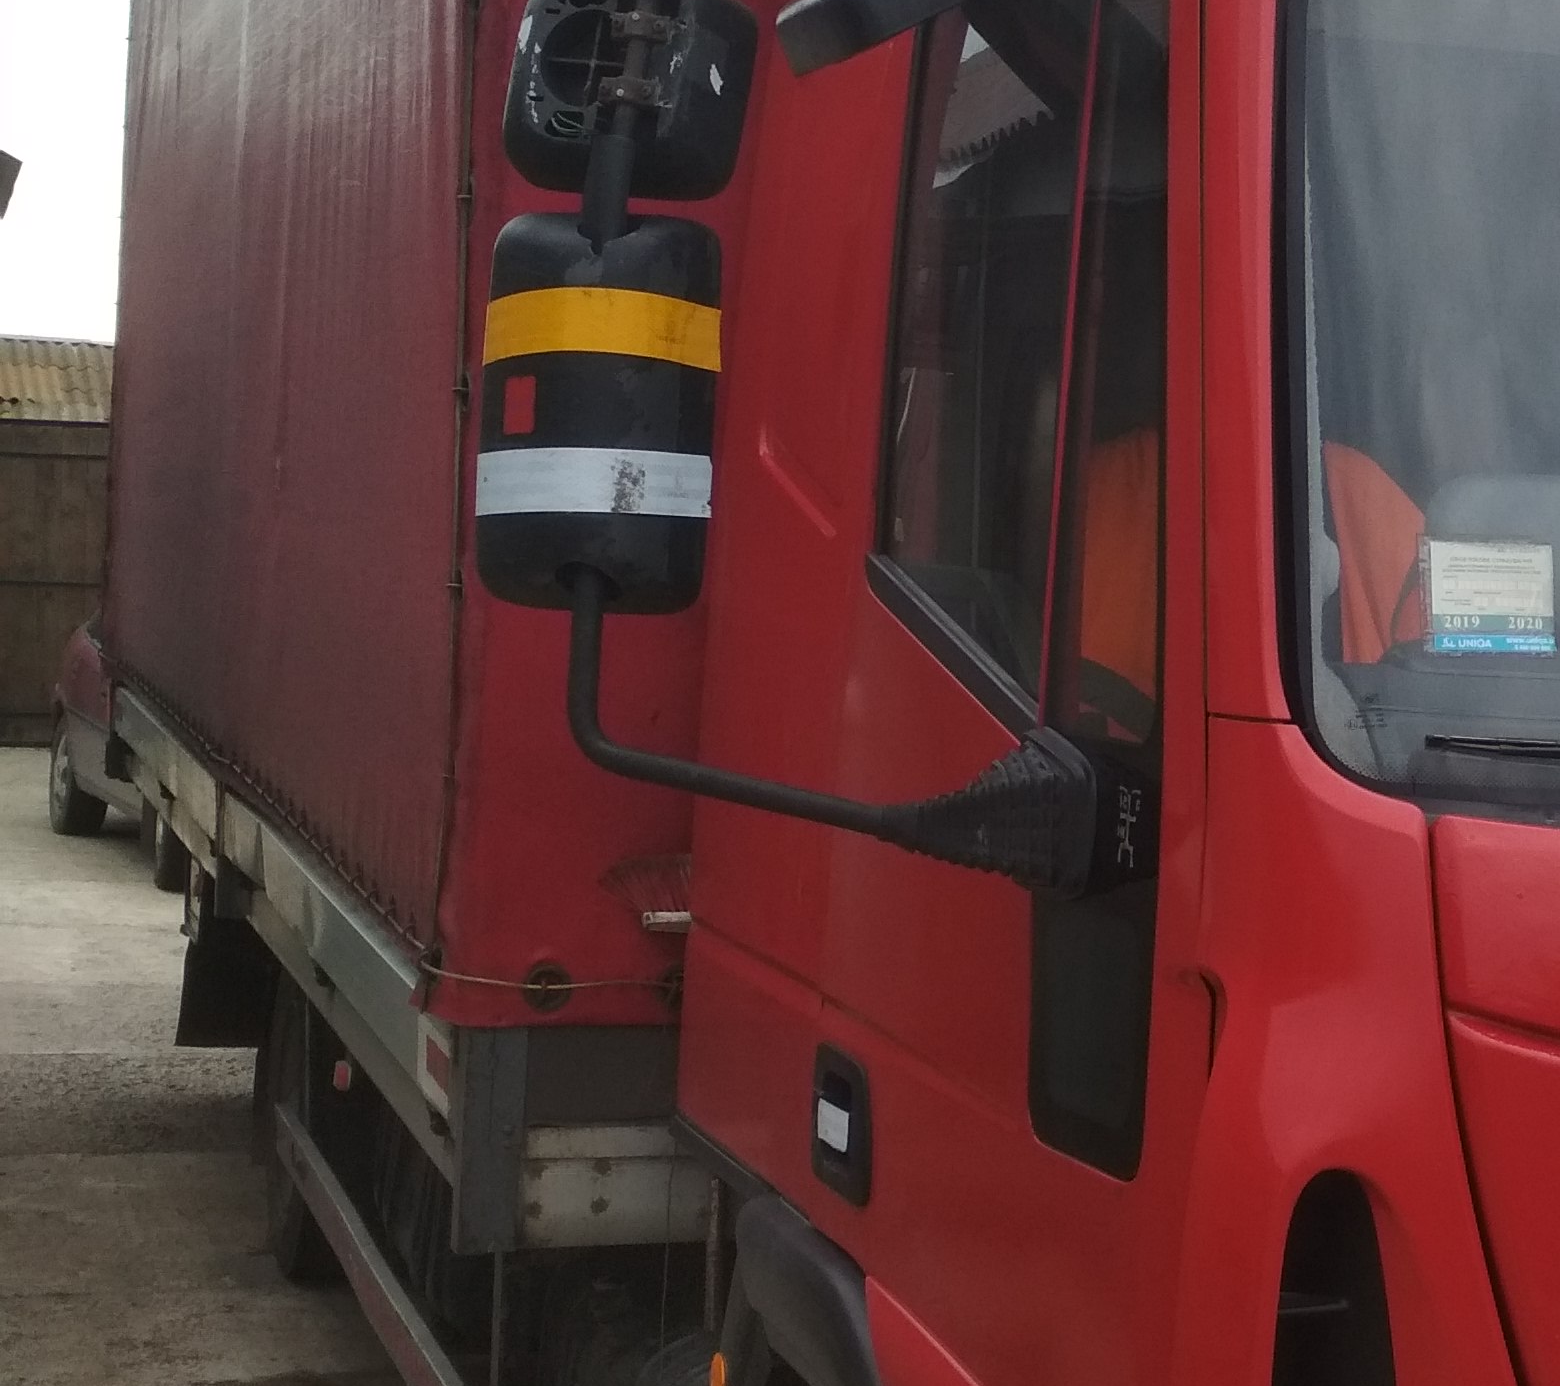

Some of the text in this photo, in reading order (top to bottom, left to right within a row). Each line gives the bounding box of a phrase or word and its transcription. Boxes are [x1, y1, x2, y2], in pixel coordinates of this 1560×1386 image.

[1444, 615, 1480, 628] 2019
[1508, 617, 1543, 630] 2020
[1458, 638, 1492, 648] UNIQA
